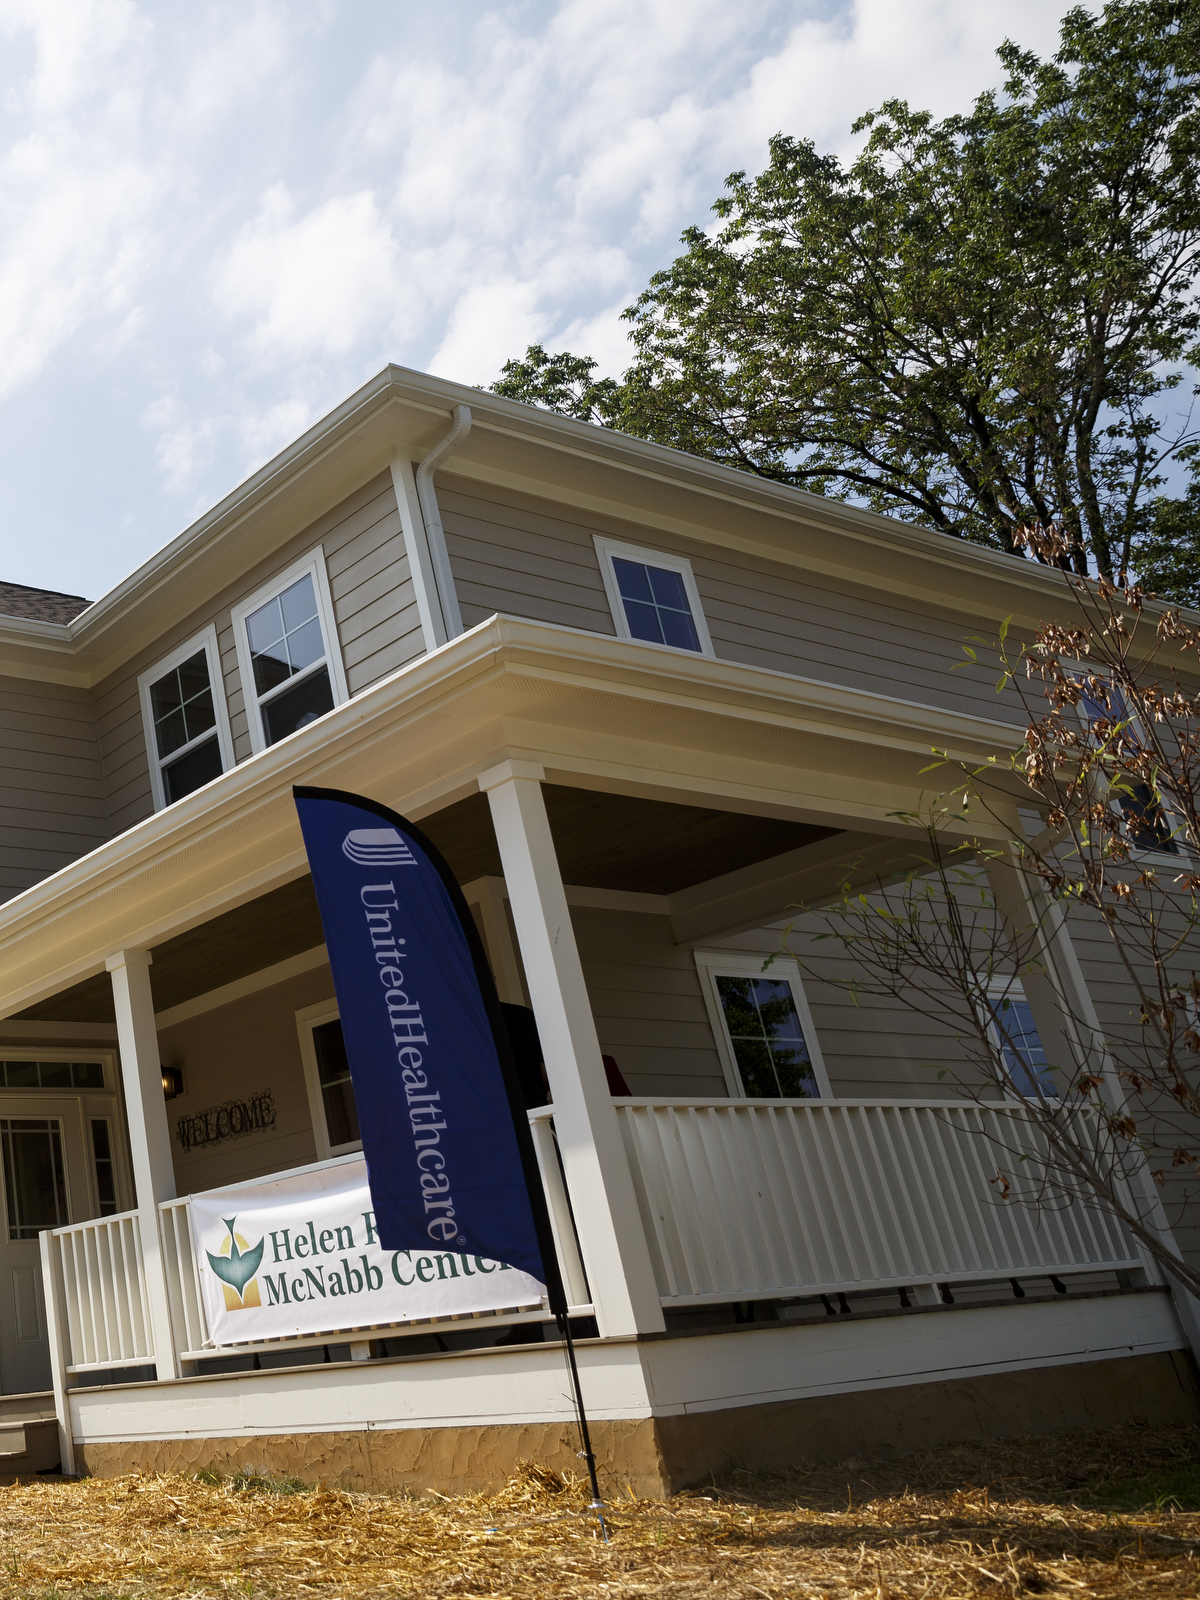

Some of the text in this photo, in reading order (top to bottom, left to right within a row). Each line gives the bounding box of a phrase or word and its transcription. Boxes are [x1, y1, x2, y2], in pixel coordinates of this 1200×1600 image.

[176, 1094, 276, 1149] WELCOME
[268, 1221, 355, 1263] Helen
[262, 1255, 384, 1307] McNabb
